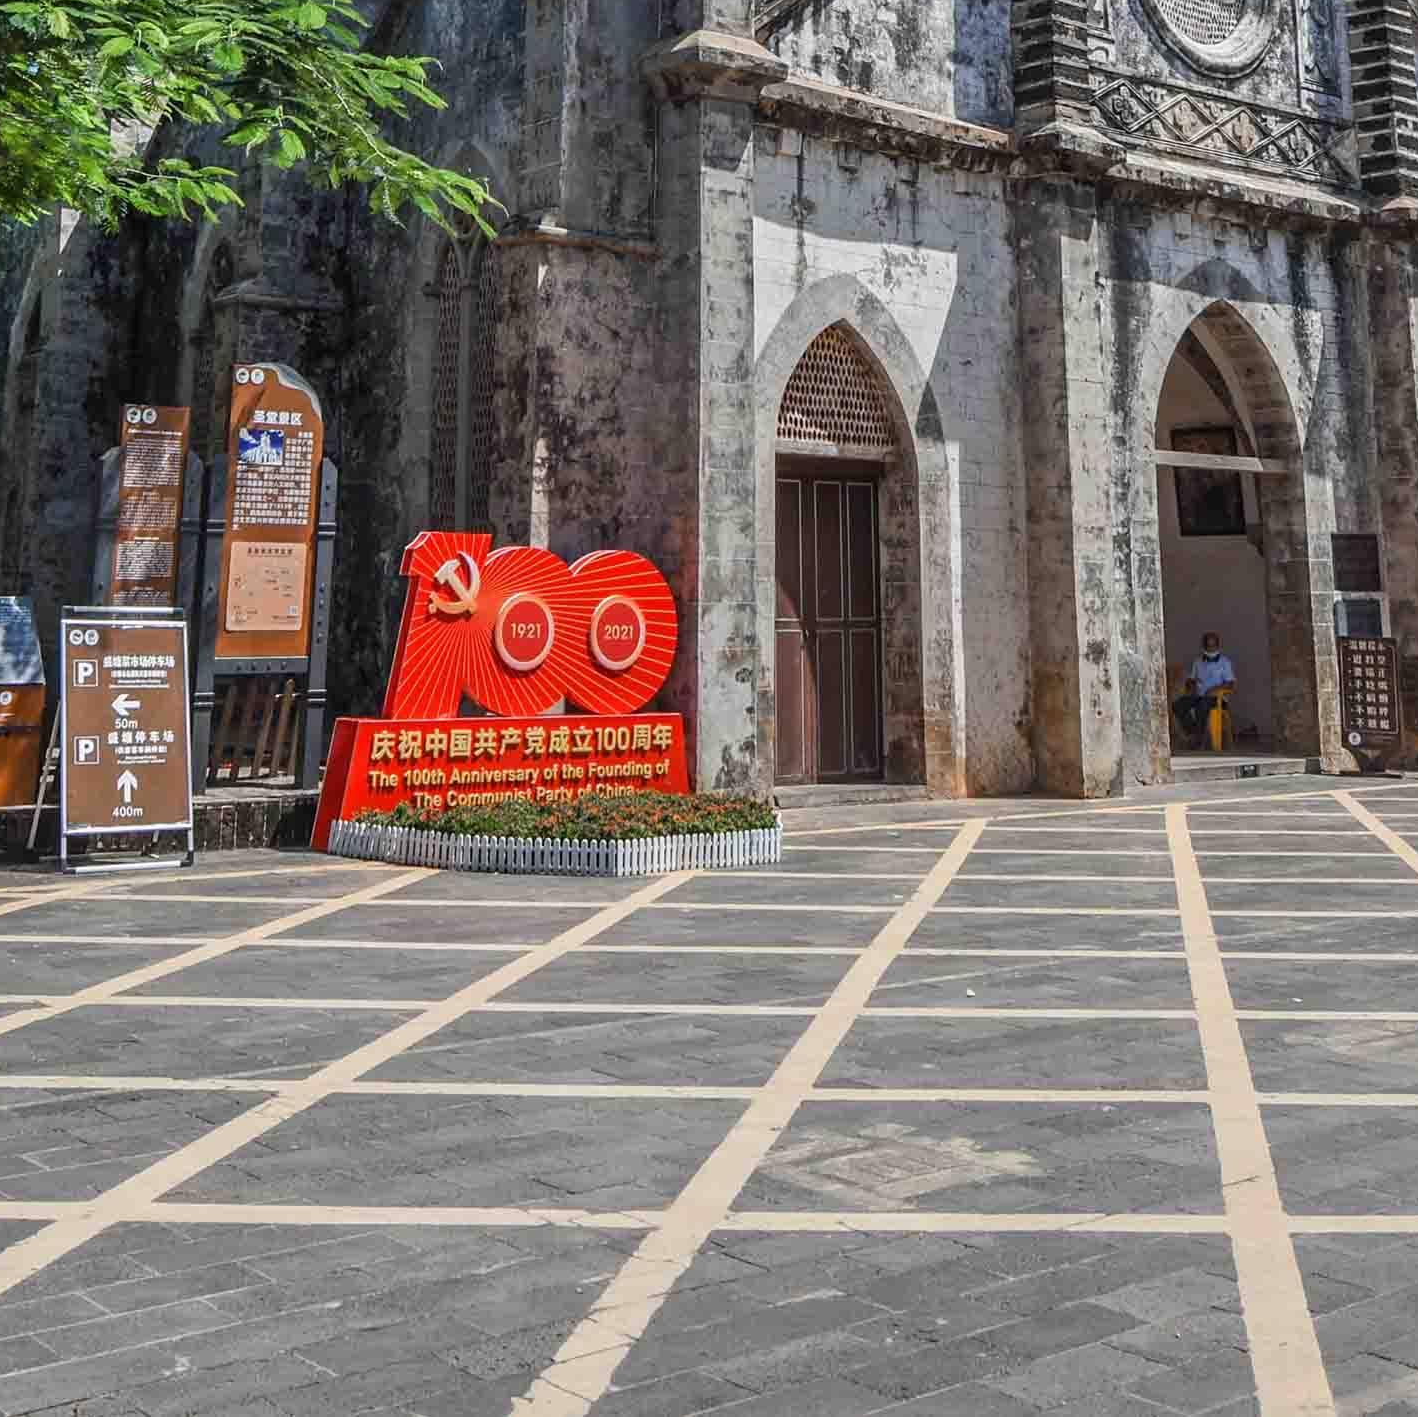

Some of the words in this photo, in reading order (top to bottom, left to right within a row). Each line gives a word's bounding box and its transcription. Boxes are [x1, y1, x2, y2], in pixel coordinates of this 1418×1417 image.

[511, 622, 542, 639] 1921
[604, 624, 634, 641] 2021
[115, 718, 138, 729] 50m
[370, 724, 673, 760] 庆祝中国共产党成立100周年
[369, 769, 398, 788] The
[404, 768, 445, 786] 100th
[449, 765, 538, 784] Anniversary
[544, 763, 559, 779] of
[561, 762, 584, 779] the
[588, 759, 653, 779] Founding
[656, 759, 670, 775] of
[414, 791, 442, 808] The
[447, 786, 532, 807] Communist
[537, 784, 573, 801] Party
[596, 783, 634, 799] China
[112, 806, 144, 817] 400m
